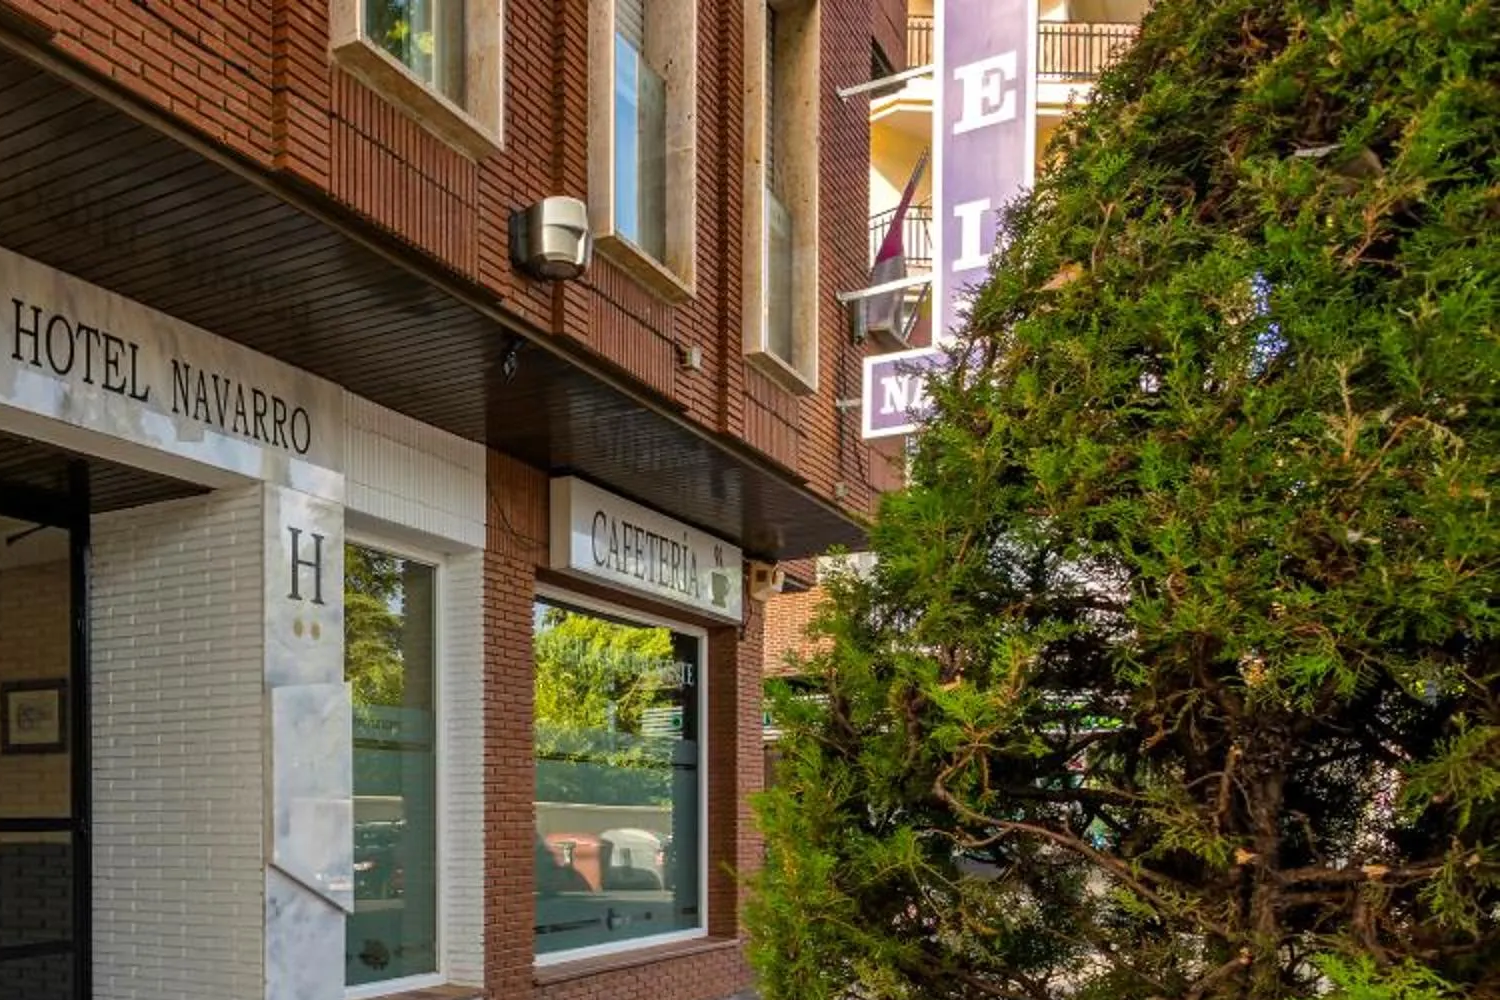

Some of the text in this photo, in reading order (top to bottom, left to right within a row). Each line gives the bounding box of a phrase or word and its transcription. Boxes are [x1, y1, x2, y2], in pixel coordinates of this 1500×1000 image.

[11, 298, 312, 455] HOTEL NAVARRO
[287, 526, 326, 606] H
[591, 510, 701, 599] CAFETERÍA
